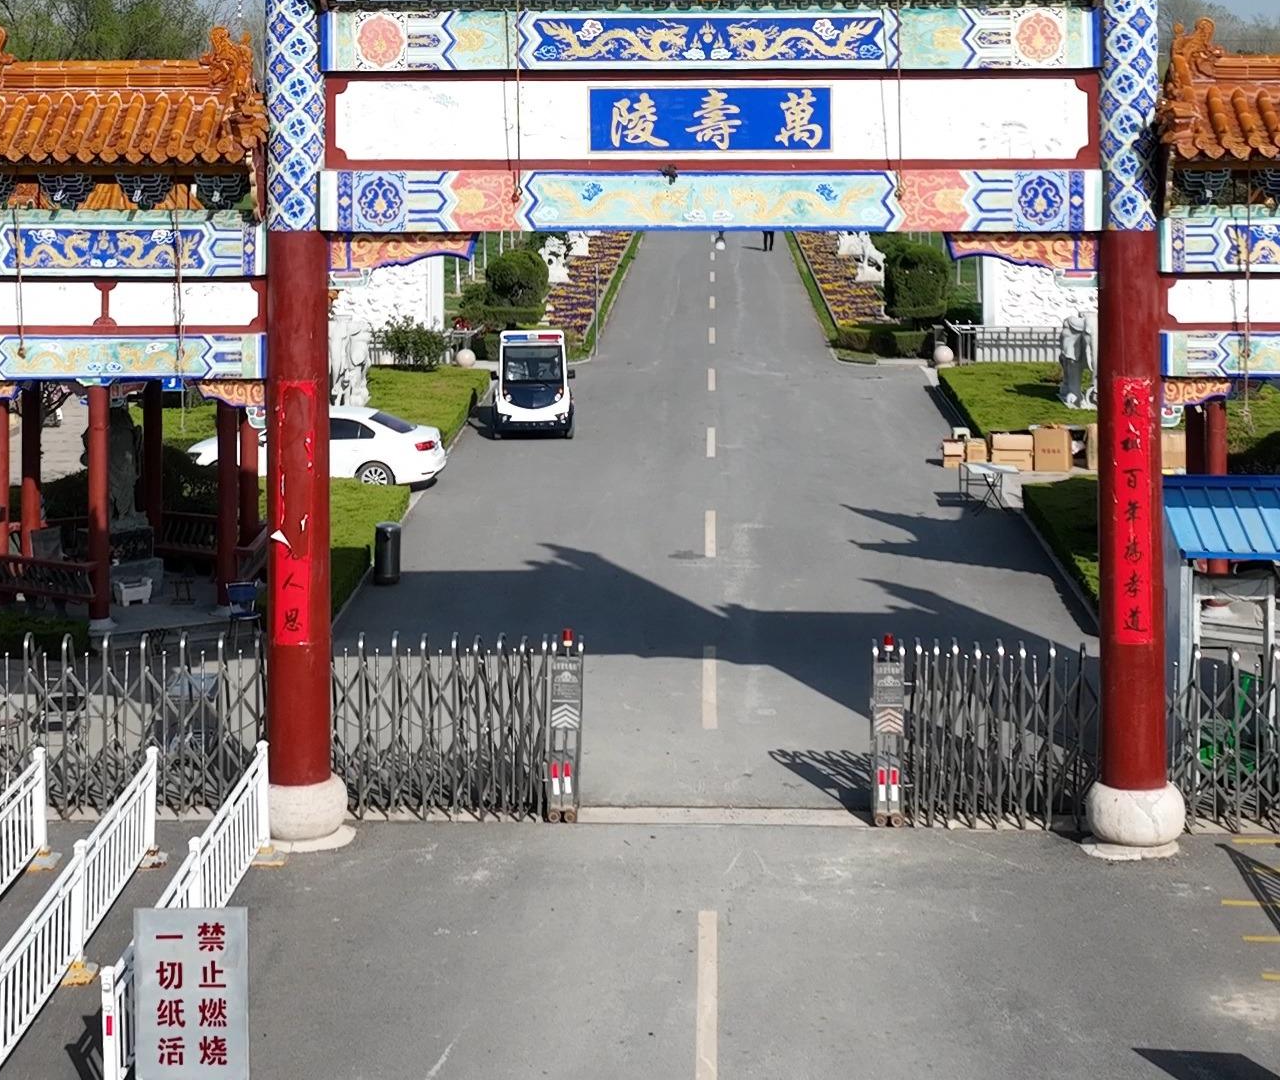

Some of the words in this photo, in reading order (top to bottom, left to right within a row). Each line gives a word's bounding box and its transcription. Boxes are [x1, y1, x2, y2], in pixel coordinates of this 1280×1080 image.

[155, 934, 186, 1066] 一切纸活
[197, 922, 228, 1066] 禁止燃烧
